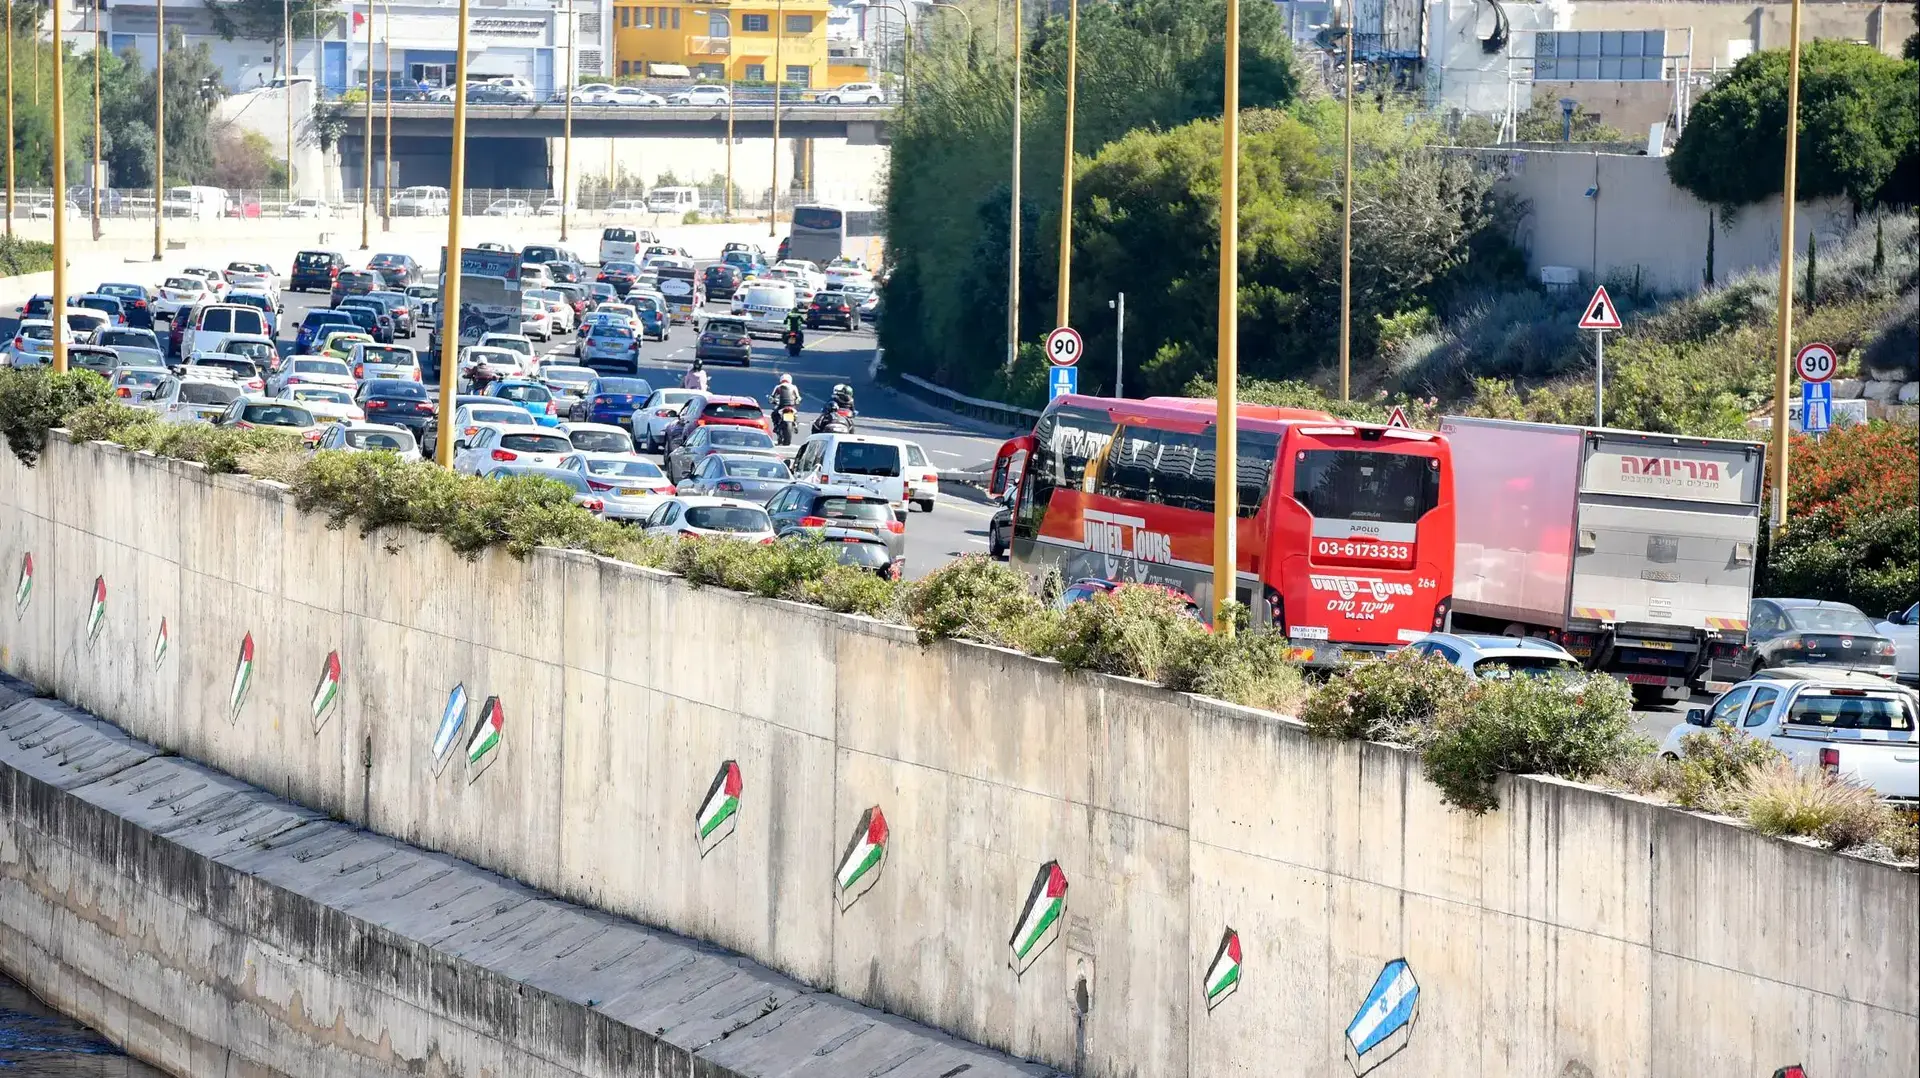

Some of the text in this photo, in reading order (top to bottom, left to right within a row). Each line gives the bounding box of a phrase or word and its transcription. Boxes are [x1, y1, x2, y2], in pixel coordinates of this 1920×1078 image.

[1055, 339, 1075, 355] 90
[1805, 355, 1829, 372] 90
[1621, 456, 1720, 482] מריומה
[1687, 480, 1719, 490] מובילים
[1350, 525, 1380, 533] APOLLO
[1083, 509, 1171, 583] UNITED TOURS
[1318, 542, 1408, 559] 03-6173333
[1309, 575, 1413, 602] UNITED TOURS
[1417, 578, 1436, 589] 264
[1327, 600, 1394, 614] יונייטד טורס
[1345, 612, 1374, 620] MAN
